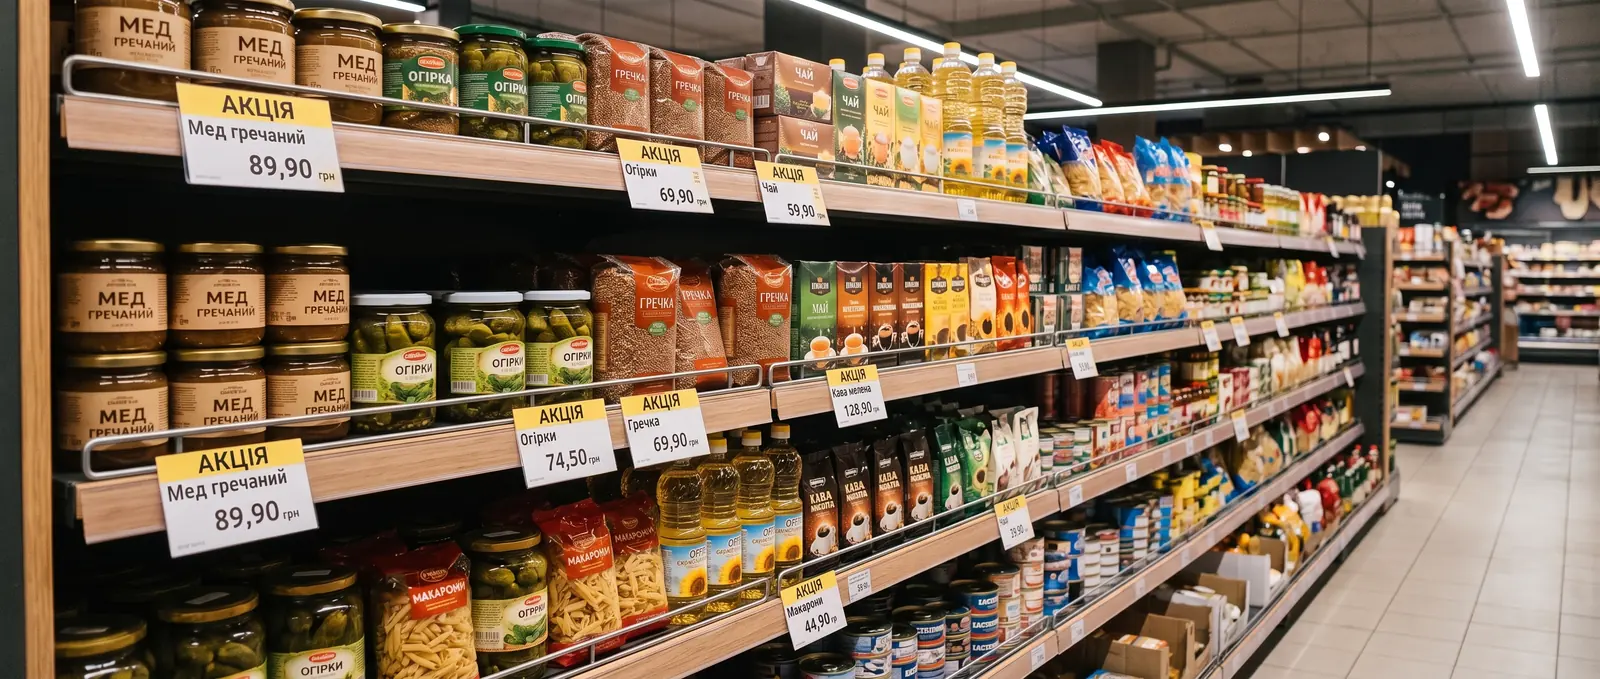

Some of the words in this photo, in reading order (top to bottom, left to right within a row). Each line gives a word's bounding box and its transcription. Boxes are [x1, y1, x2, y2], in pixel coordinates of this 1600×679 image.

[120, 16, 172, 39] МЕД
[114, 37, 176, 53] ГРЕЧАНИЙ
[238, 35, 284, 58] МЕД
[233, 54, 287, 70] ГРЕЧАНИЙ
[338, 53, 377, 75] МЕД
[615, 69, 646, 83] ГРЕЧКА
[795, 66, 814, 81] ЧАЙ
[675, 80, 701, 93] ГРЕЧКА
[728, 90, 751, 103] ГРЕЧКА
[842, 94, 860, 109] ЧАЙ
[222, 94, 295, 121] АКЦІЯ
[873, 104, 890, 118] ЧАЙ
[188, 119, 227, 140] Мед
[231, 126, 306, 145] гречаний
[800, 128, 819, 142] ЧАЙ
[641, 145, 682, 164] АКЦІЯ
[249, 154, 313, 181] 89,90
[318, 171, 335, 181] грн
[625, 163, 658, 180] Огірки
[772, 166, 805, 183] АКЦІЯ
[762, 182, 779, 194] Чай
[660, 187, 694, 206] 69,90
[787, 203, 815, 219] 59,90
[98, 291, 145, 309] МЕД
[206, 291, 248, 307] МЕД
[313, 290, 345, 304] МЕД
[640, 297, 674, 309] ГРЕЧКА
[682, 290, 712, 300] ГРЕЧКА
[760, 292, 789, 303] ГРЕЧКА
[88, 307, 153, 320] ГРЕЧАНИЙ
[197, 306, 255, 317] ГРЕЧАНИЙ
[492, 356, 523, 368] ОГІРКИ
[563, 351, 591, 362] ОГІРКИ
[395, 363, 432, 376] ОГІРКИ
[841, 368, 867, 382] АКЦІЯ
[314, 388, 345, 403] МЕД
[832, 388, 848, 398] Кава
[849, 384, 872, 395] мелена
[213, 396, 253, 412] МЕД
[643, 393, 681, 411] АКЦІЯ
[844, 401, 872, 417] 128,90
[99, 407, 147, 425] МЕД
[203, 411, 259, 426] ГРЕЧАНИЙ
[540, 404, 584, 424] АКЦІЯ
[628, 416, 660, 433] Гречка
[520, 431, 557, 446] Огірки
[653, 432, 688, 453] 69,90
[198, 446, 269, 474] АКЦІЯ
[546, 448, 587, 471] 74,50
[588, 455, 600, 464] грн
[167, 484, 207, 502] Мед
[212, 468, 288, 498] гречаний
[810, 490, 833, 504] КАВА
[215, 500, 280, 531] 89,90
[283, 508, 300, 521] грн
[796, 579, 823, 599] АКЦІЯ
[805, 612, 830, 633] 44,90
[301, 661, 343, 676] ОГІРКИ
